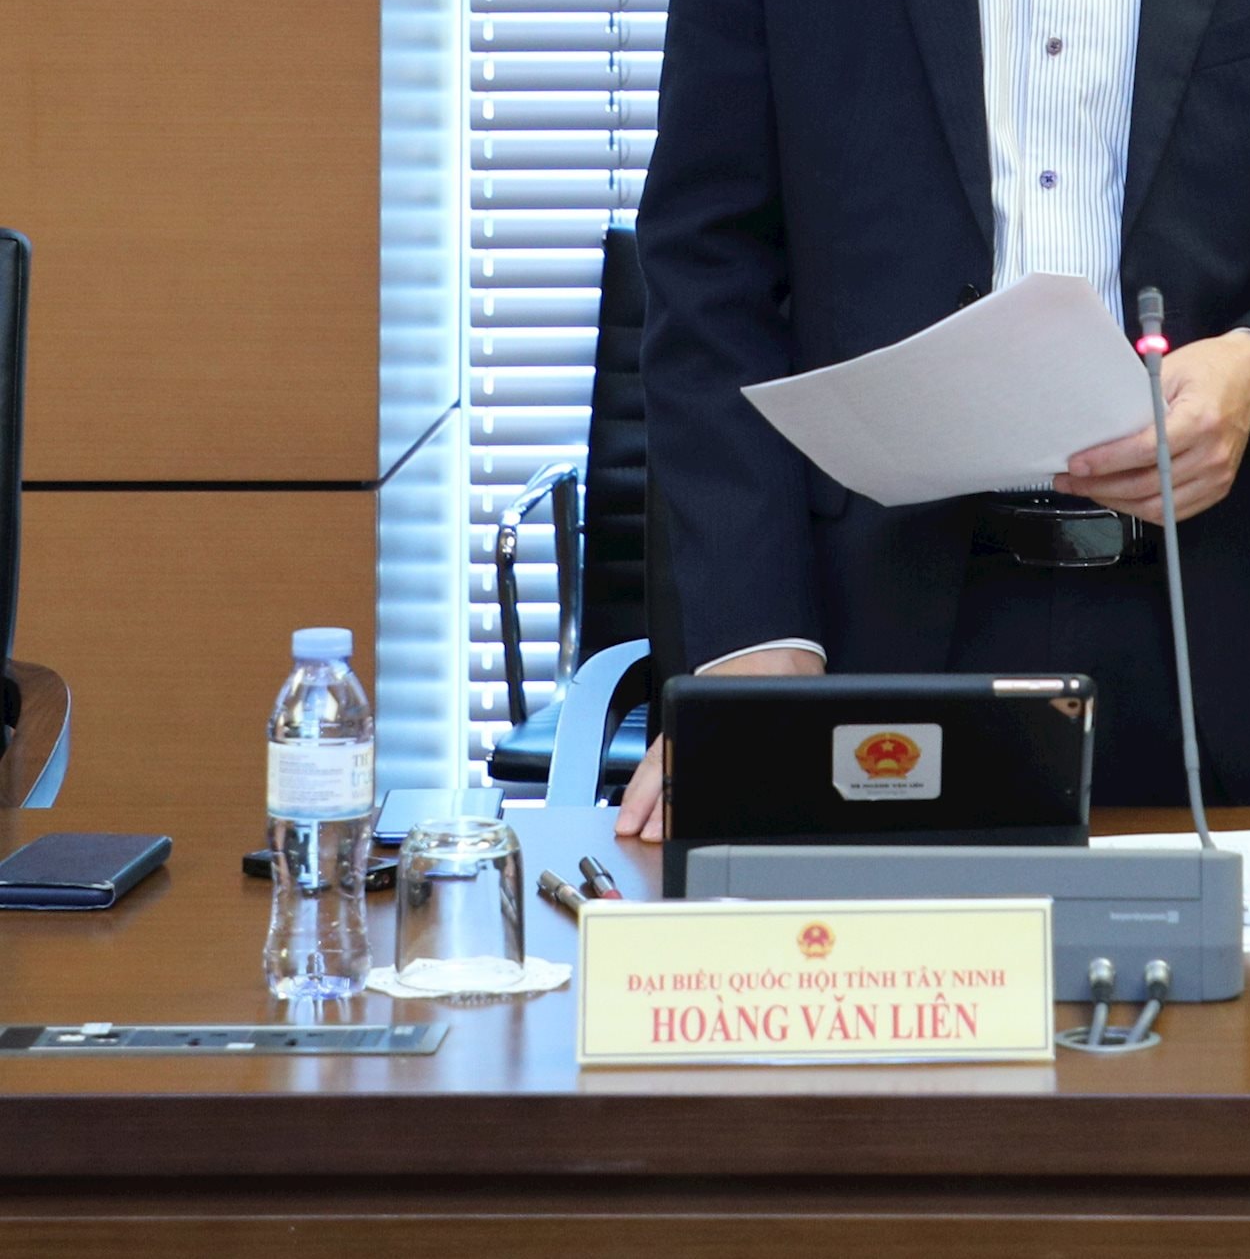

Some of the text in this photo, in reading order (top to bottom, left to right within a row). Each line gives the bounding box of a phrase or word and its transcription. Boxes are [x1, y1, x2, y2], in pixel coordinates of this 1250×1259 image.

[627, 965, 1006, 995] ĐẠI BIỂU QUỐC HỘI TỈNH TÂY NINH
[651, 991, 979, 1043] HOÀNG VĂN LIÊN
